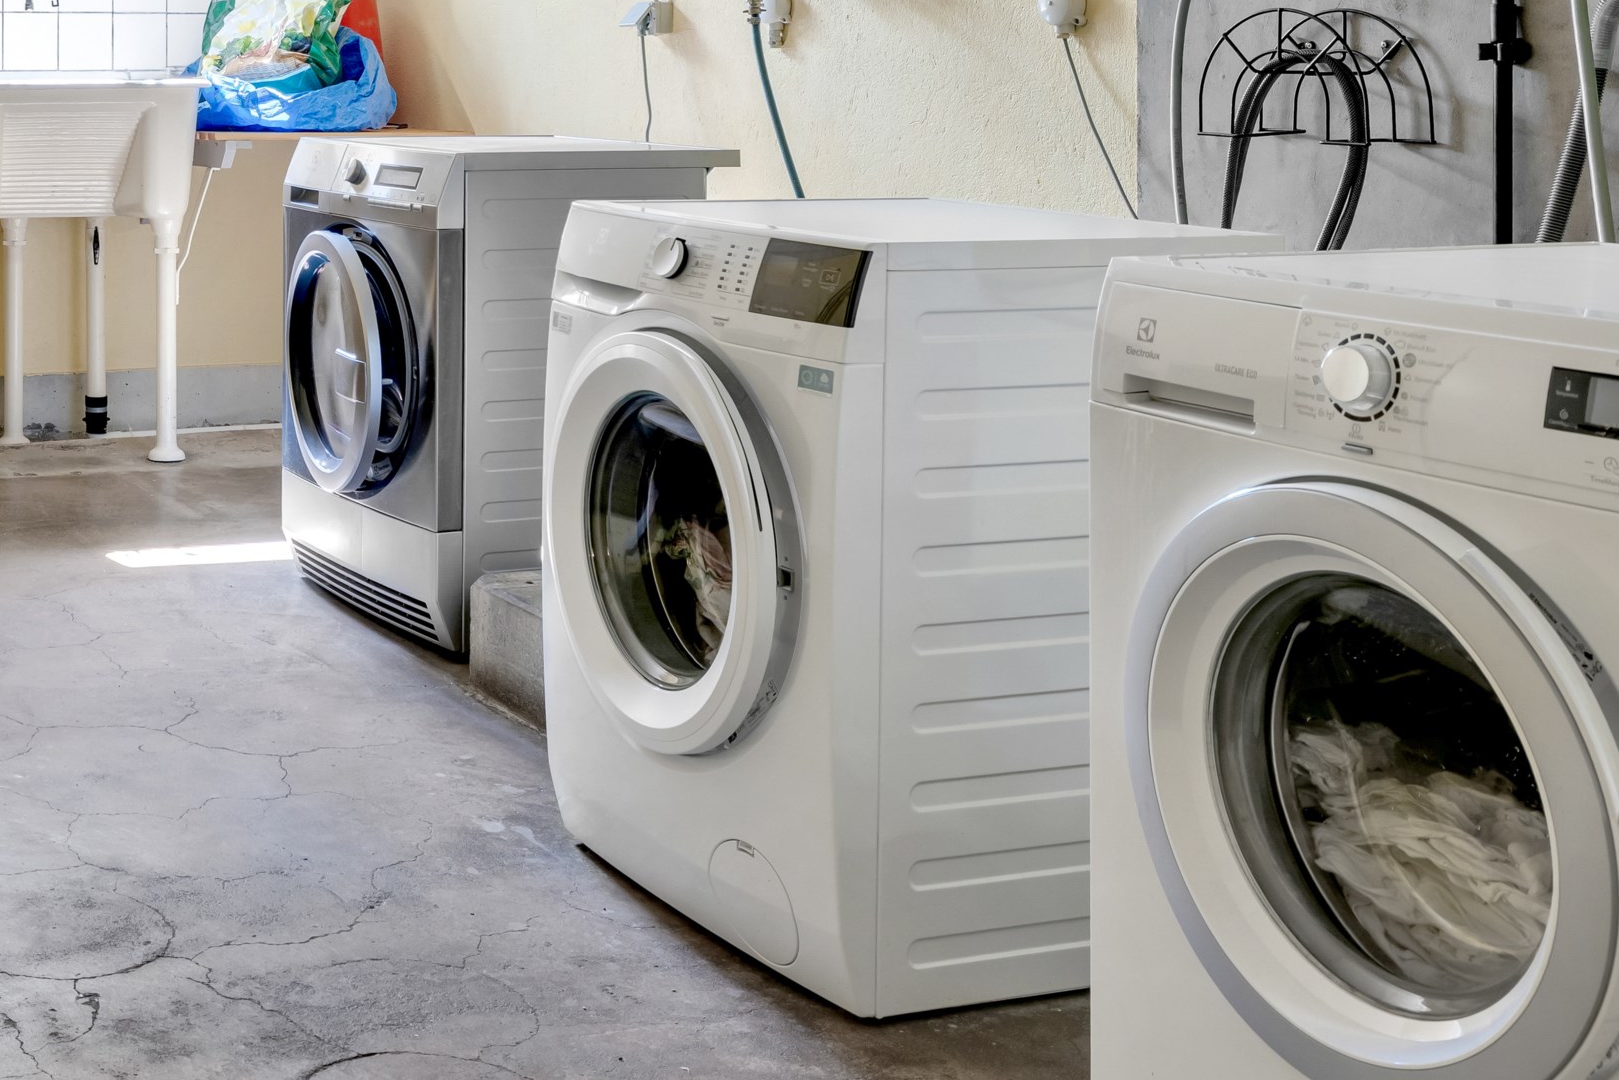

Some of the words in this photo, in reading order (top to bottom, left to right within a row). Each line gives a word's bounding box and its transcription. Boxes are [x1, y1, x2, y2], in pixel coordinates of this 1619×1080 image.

[1126, 345, 1160, 360] Electrolux
[1215, 363, 1245, 377] ULTRACARE
[1246, 368, 1258, 379] ECO
